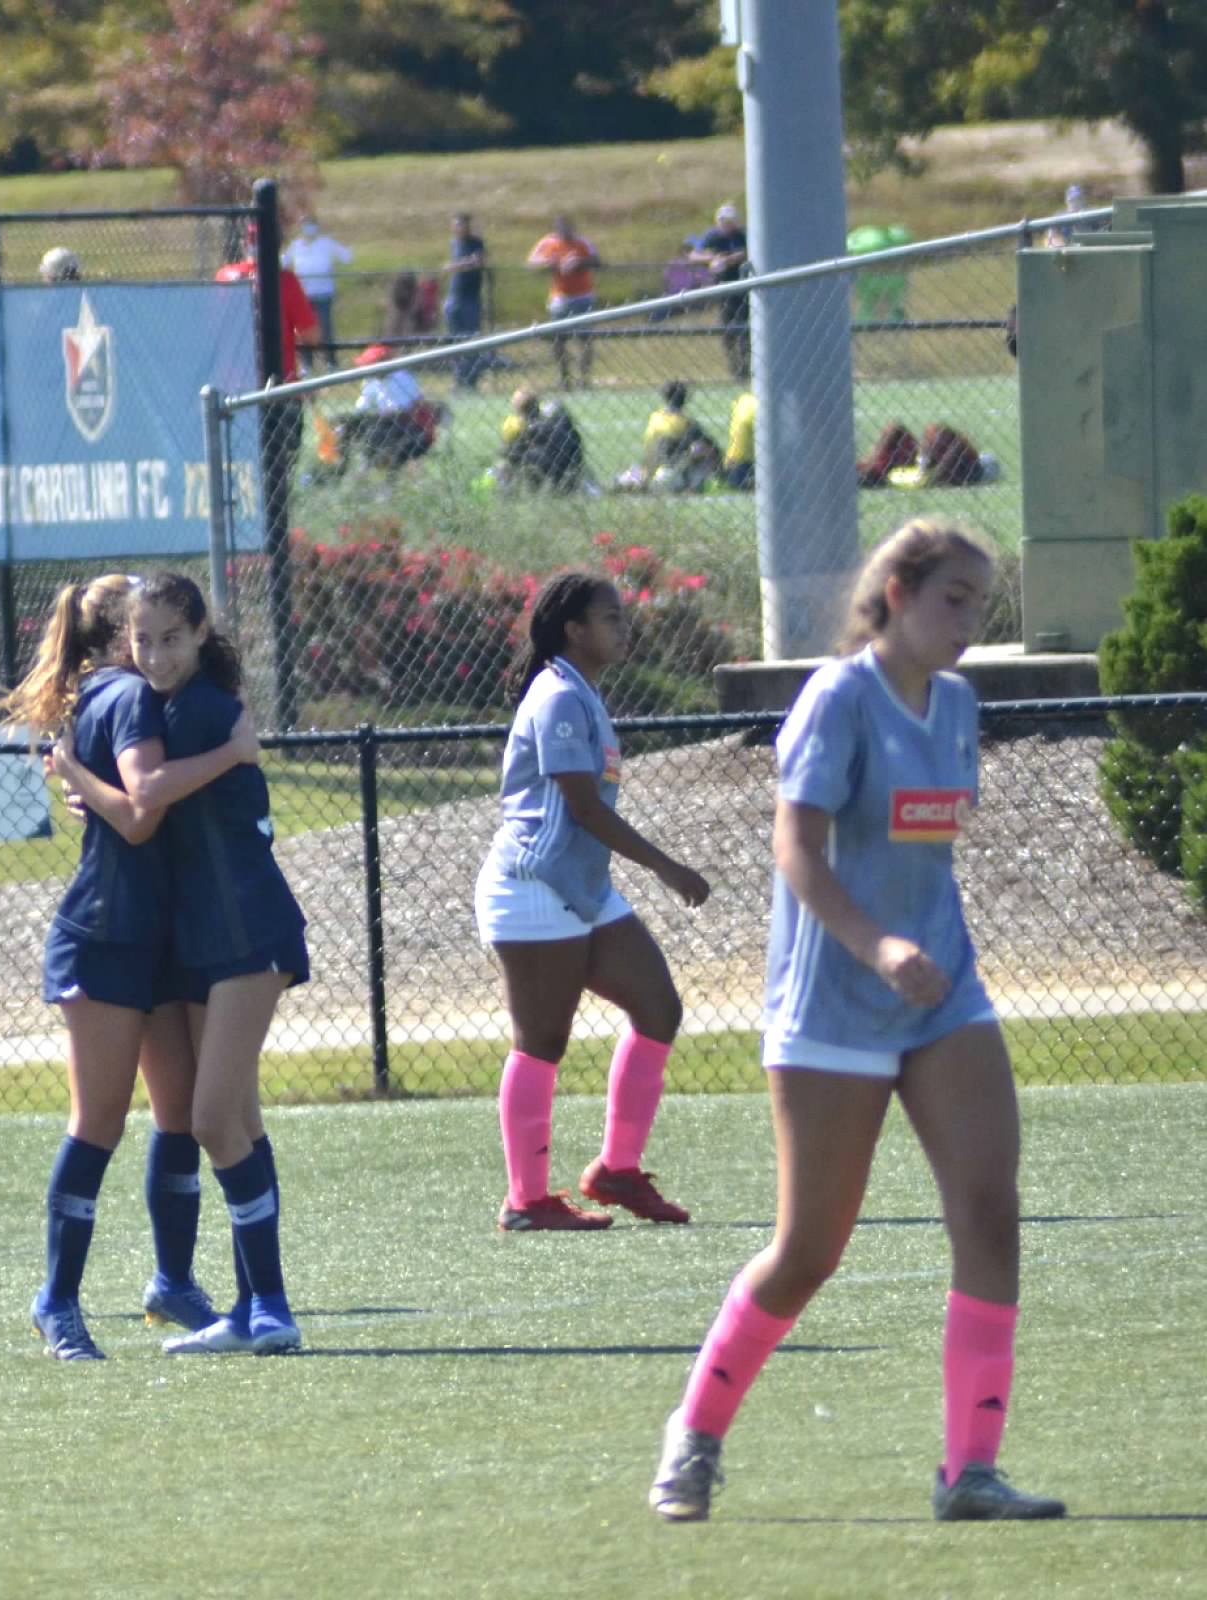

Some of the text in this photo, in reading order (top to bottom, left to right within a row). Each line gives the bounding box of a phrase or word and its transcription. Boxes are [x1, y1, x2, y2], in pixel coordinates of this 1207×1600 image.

[20, 460, 128, 524] CAROLINA
[137, 459, 169, 519] FC
[183, 461, 257, 520] YOH
[900, 803, 953, 821] CIRCLE
